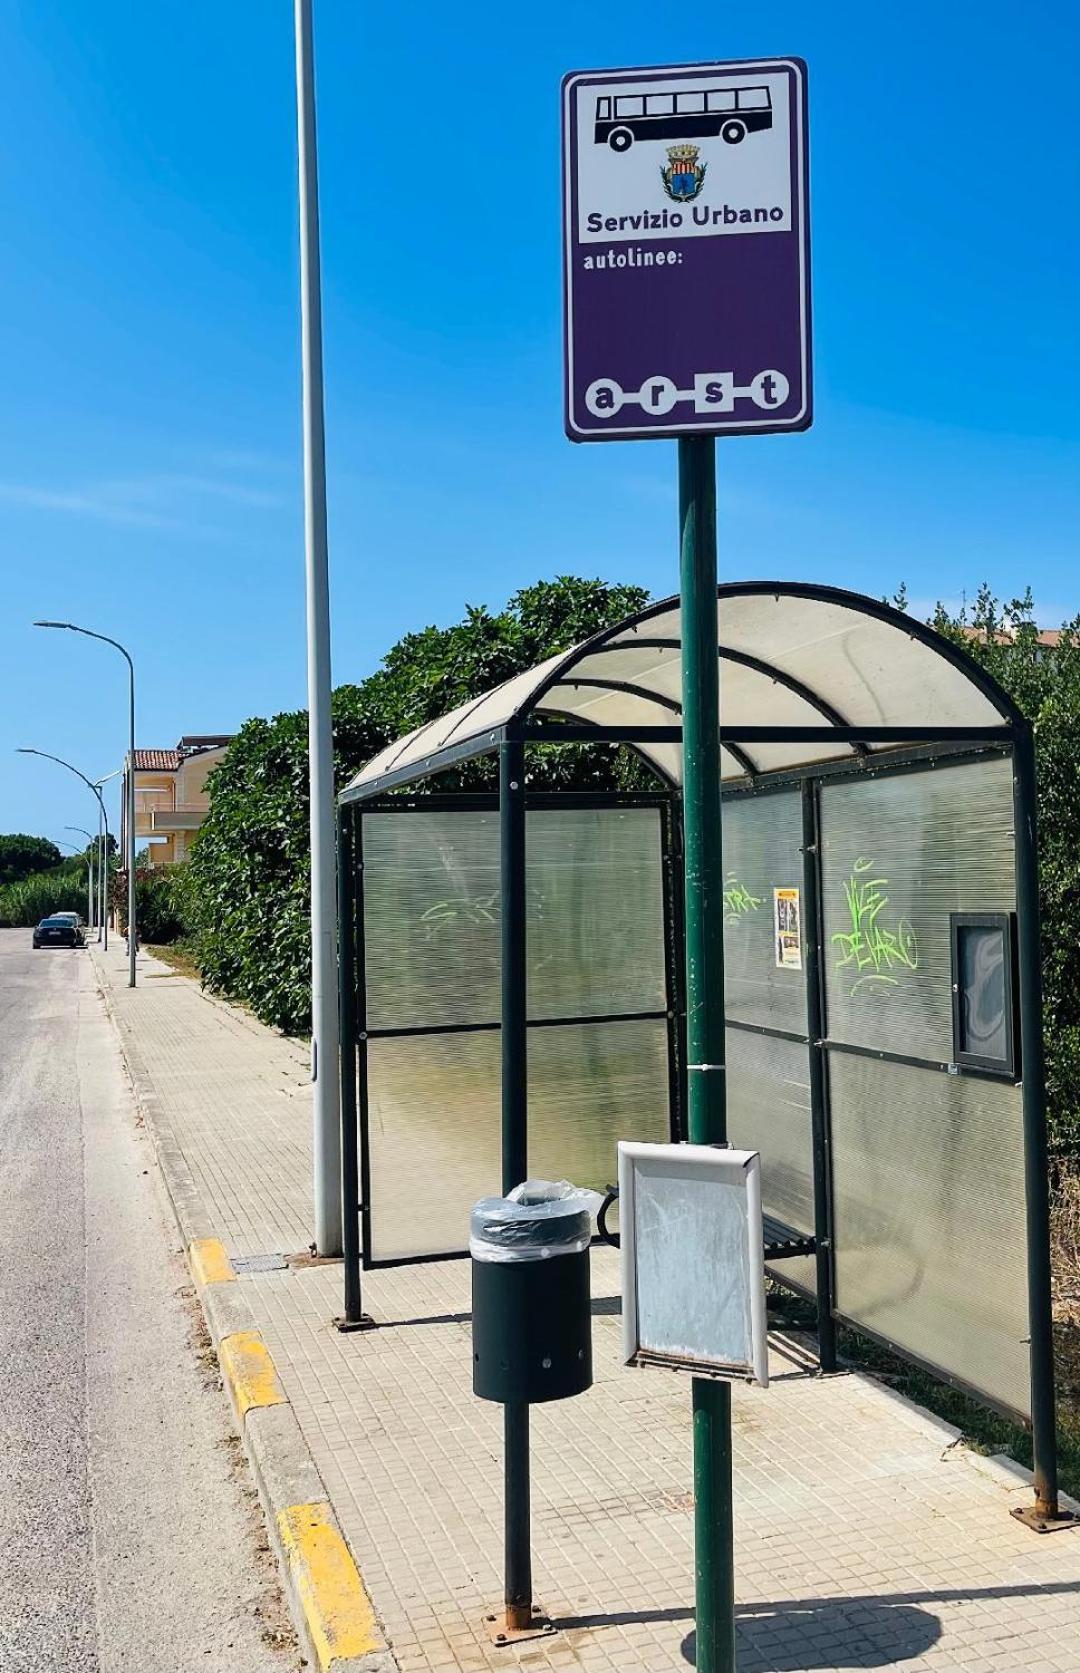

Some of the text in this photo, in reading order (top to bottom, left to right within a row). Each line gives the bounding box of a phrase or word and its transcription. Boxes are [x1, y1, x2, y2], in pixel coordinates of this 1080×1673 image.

[586, 205, 784, 232] Servizio Urbano
[583, 248, 683, 269] autolinee:
